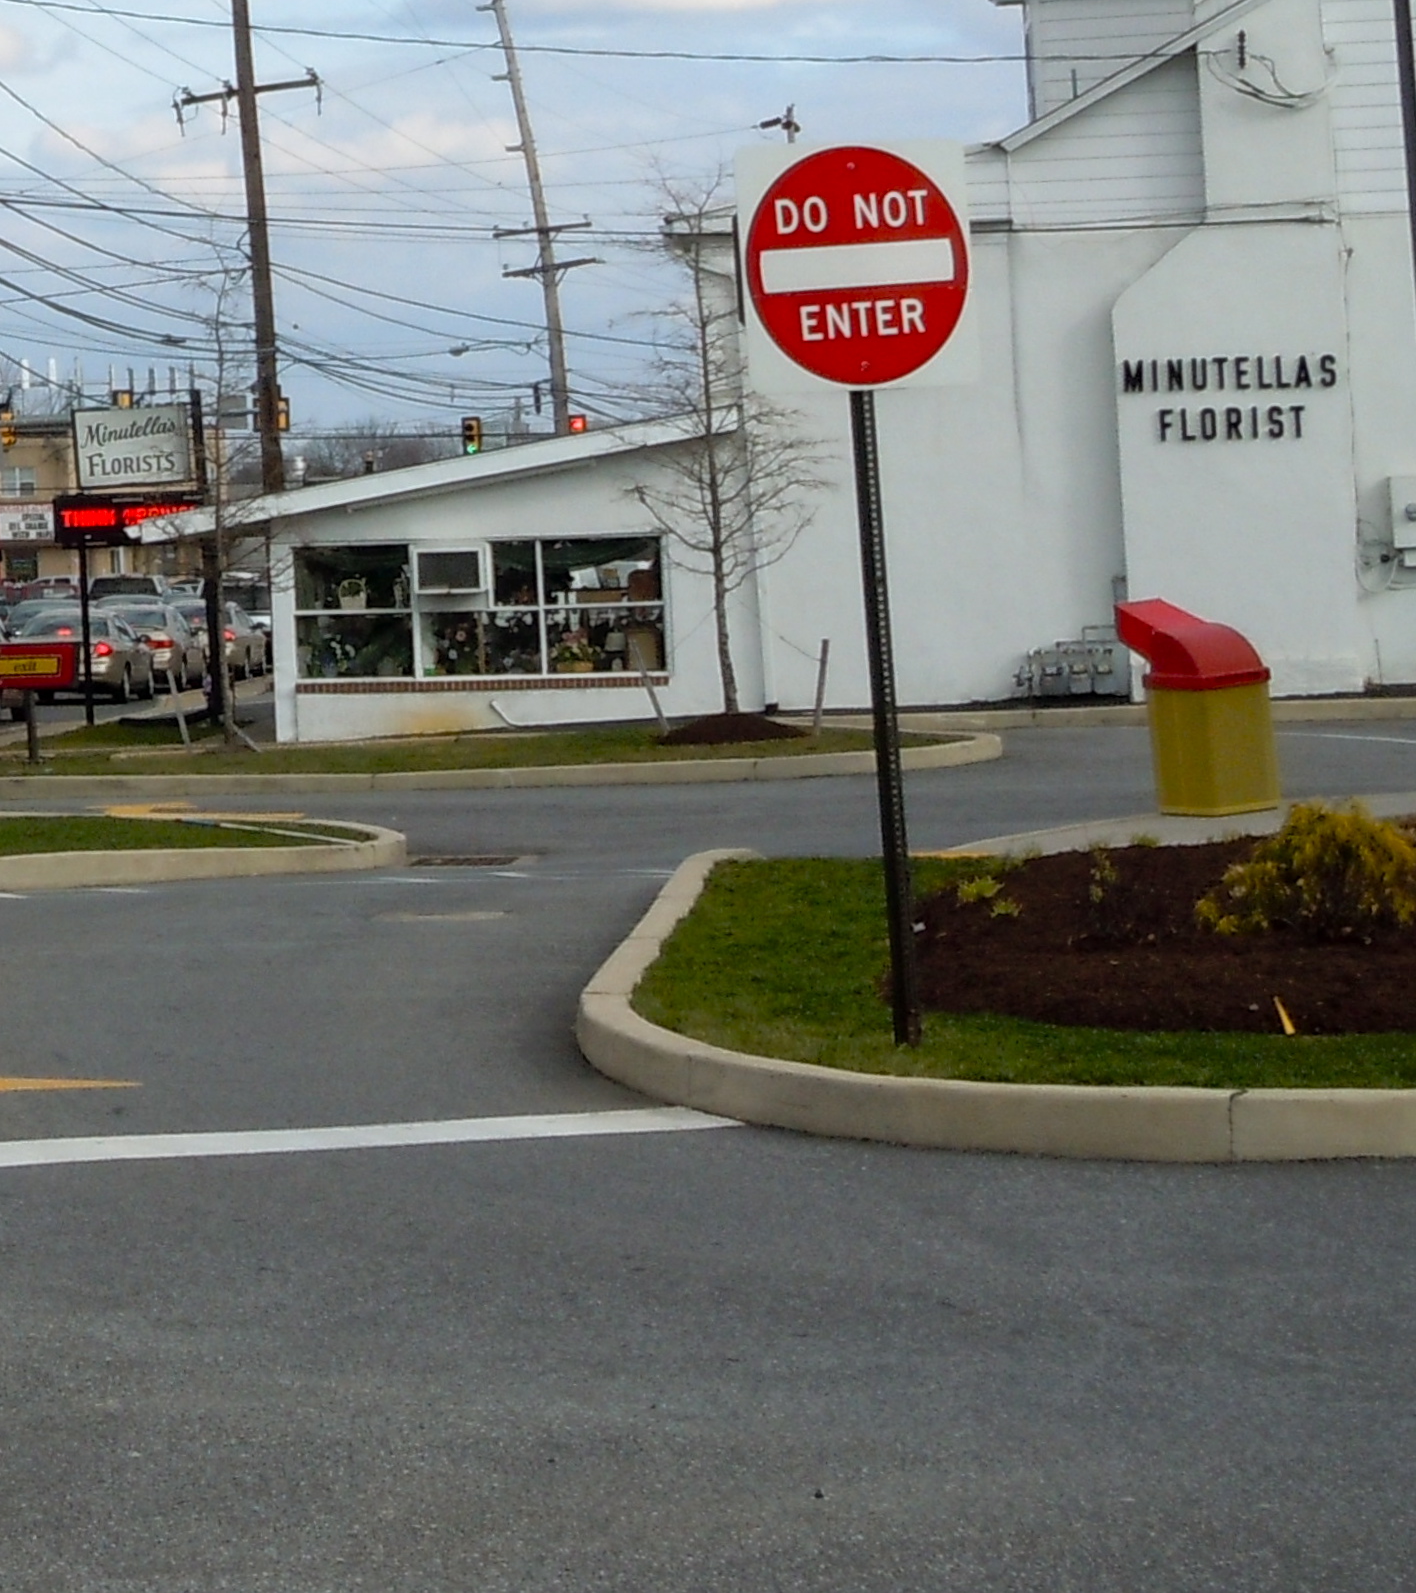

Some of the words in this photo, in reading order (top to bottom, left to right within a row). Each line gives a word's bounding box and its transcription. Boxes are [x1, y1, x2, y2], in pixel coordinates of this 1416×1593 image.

[775, 195, 827, 235] DO
[853, 189, 928, 228] NOT
[799, 299, 926, 342] ENTER
[1123, 354, 1336, 393] MINUTELLAS
[80, 415, 176, 449] Minutella's
[1158, 405, 1306, 442] FLORIST
[86, 451, 176, 477] FLORISTS
[14, 661, 37, 672] exit
